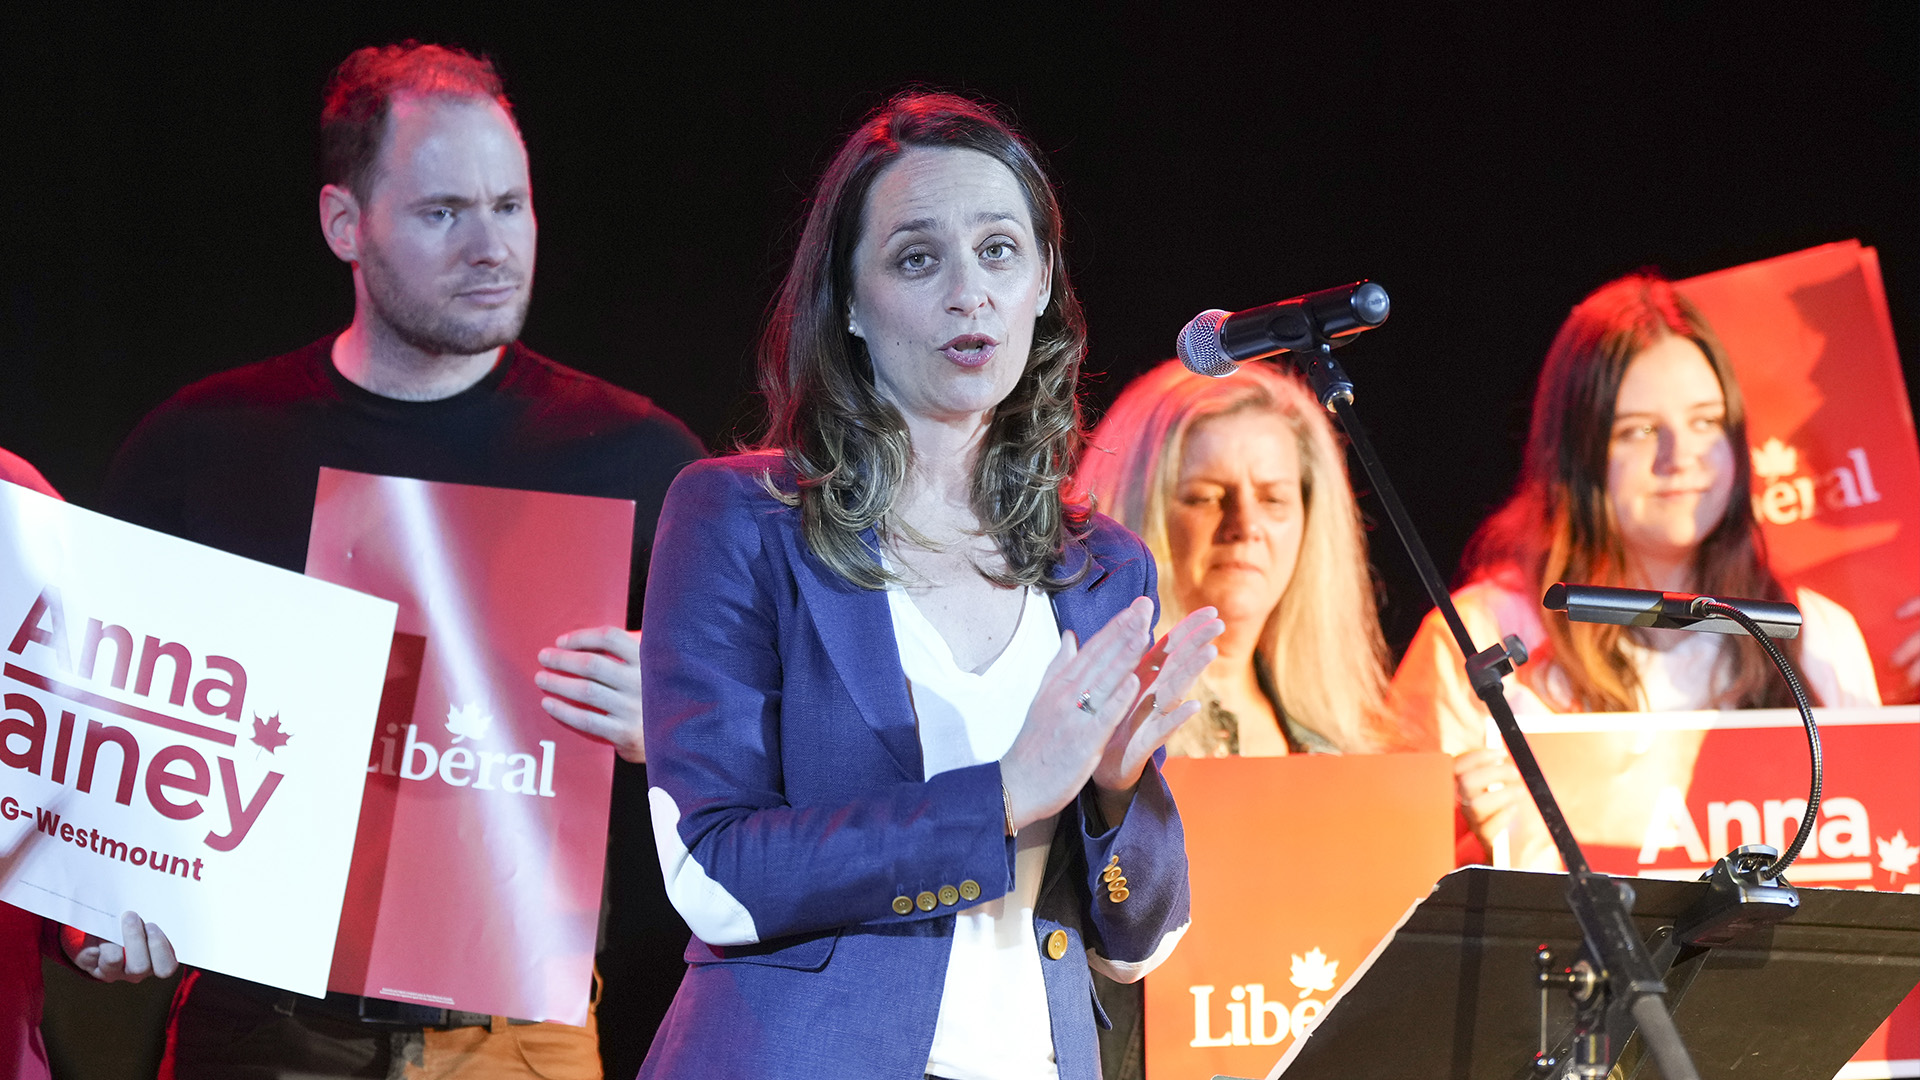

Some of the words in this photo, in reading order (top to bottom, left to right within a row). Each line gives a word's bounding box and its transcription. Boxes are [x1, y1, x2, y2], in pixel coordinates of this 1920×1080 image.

[7, 583, 247, 723] Anna
[0, 693, 285, 852] ainey
[367, 722, 556, 798] ibéral
[0, 796, 204, 882] G-Westmount
[1637, 783, 1871, 865] Anna
[1188, 983, 1333, 1048] Libé
